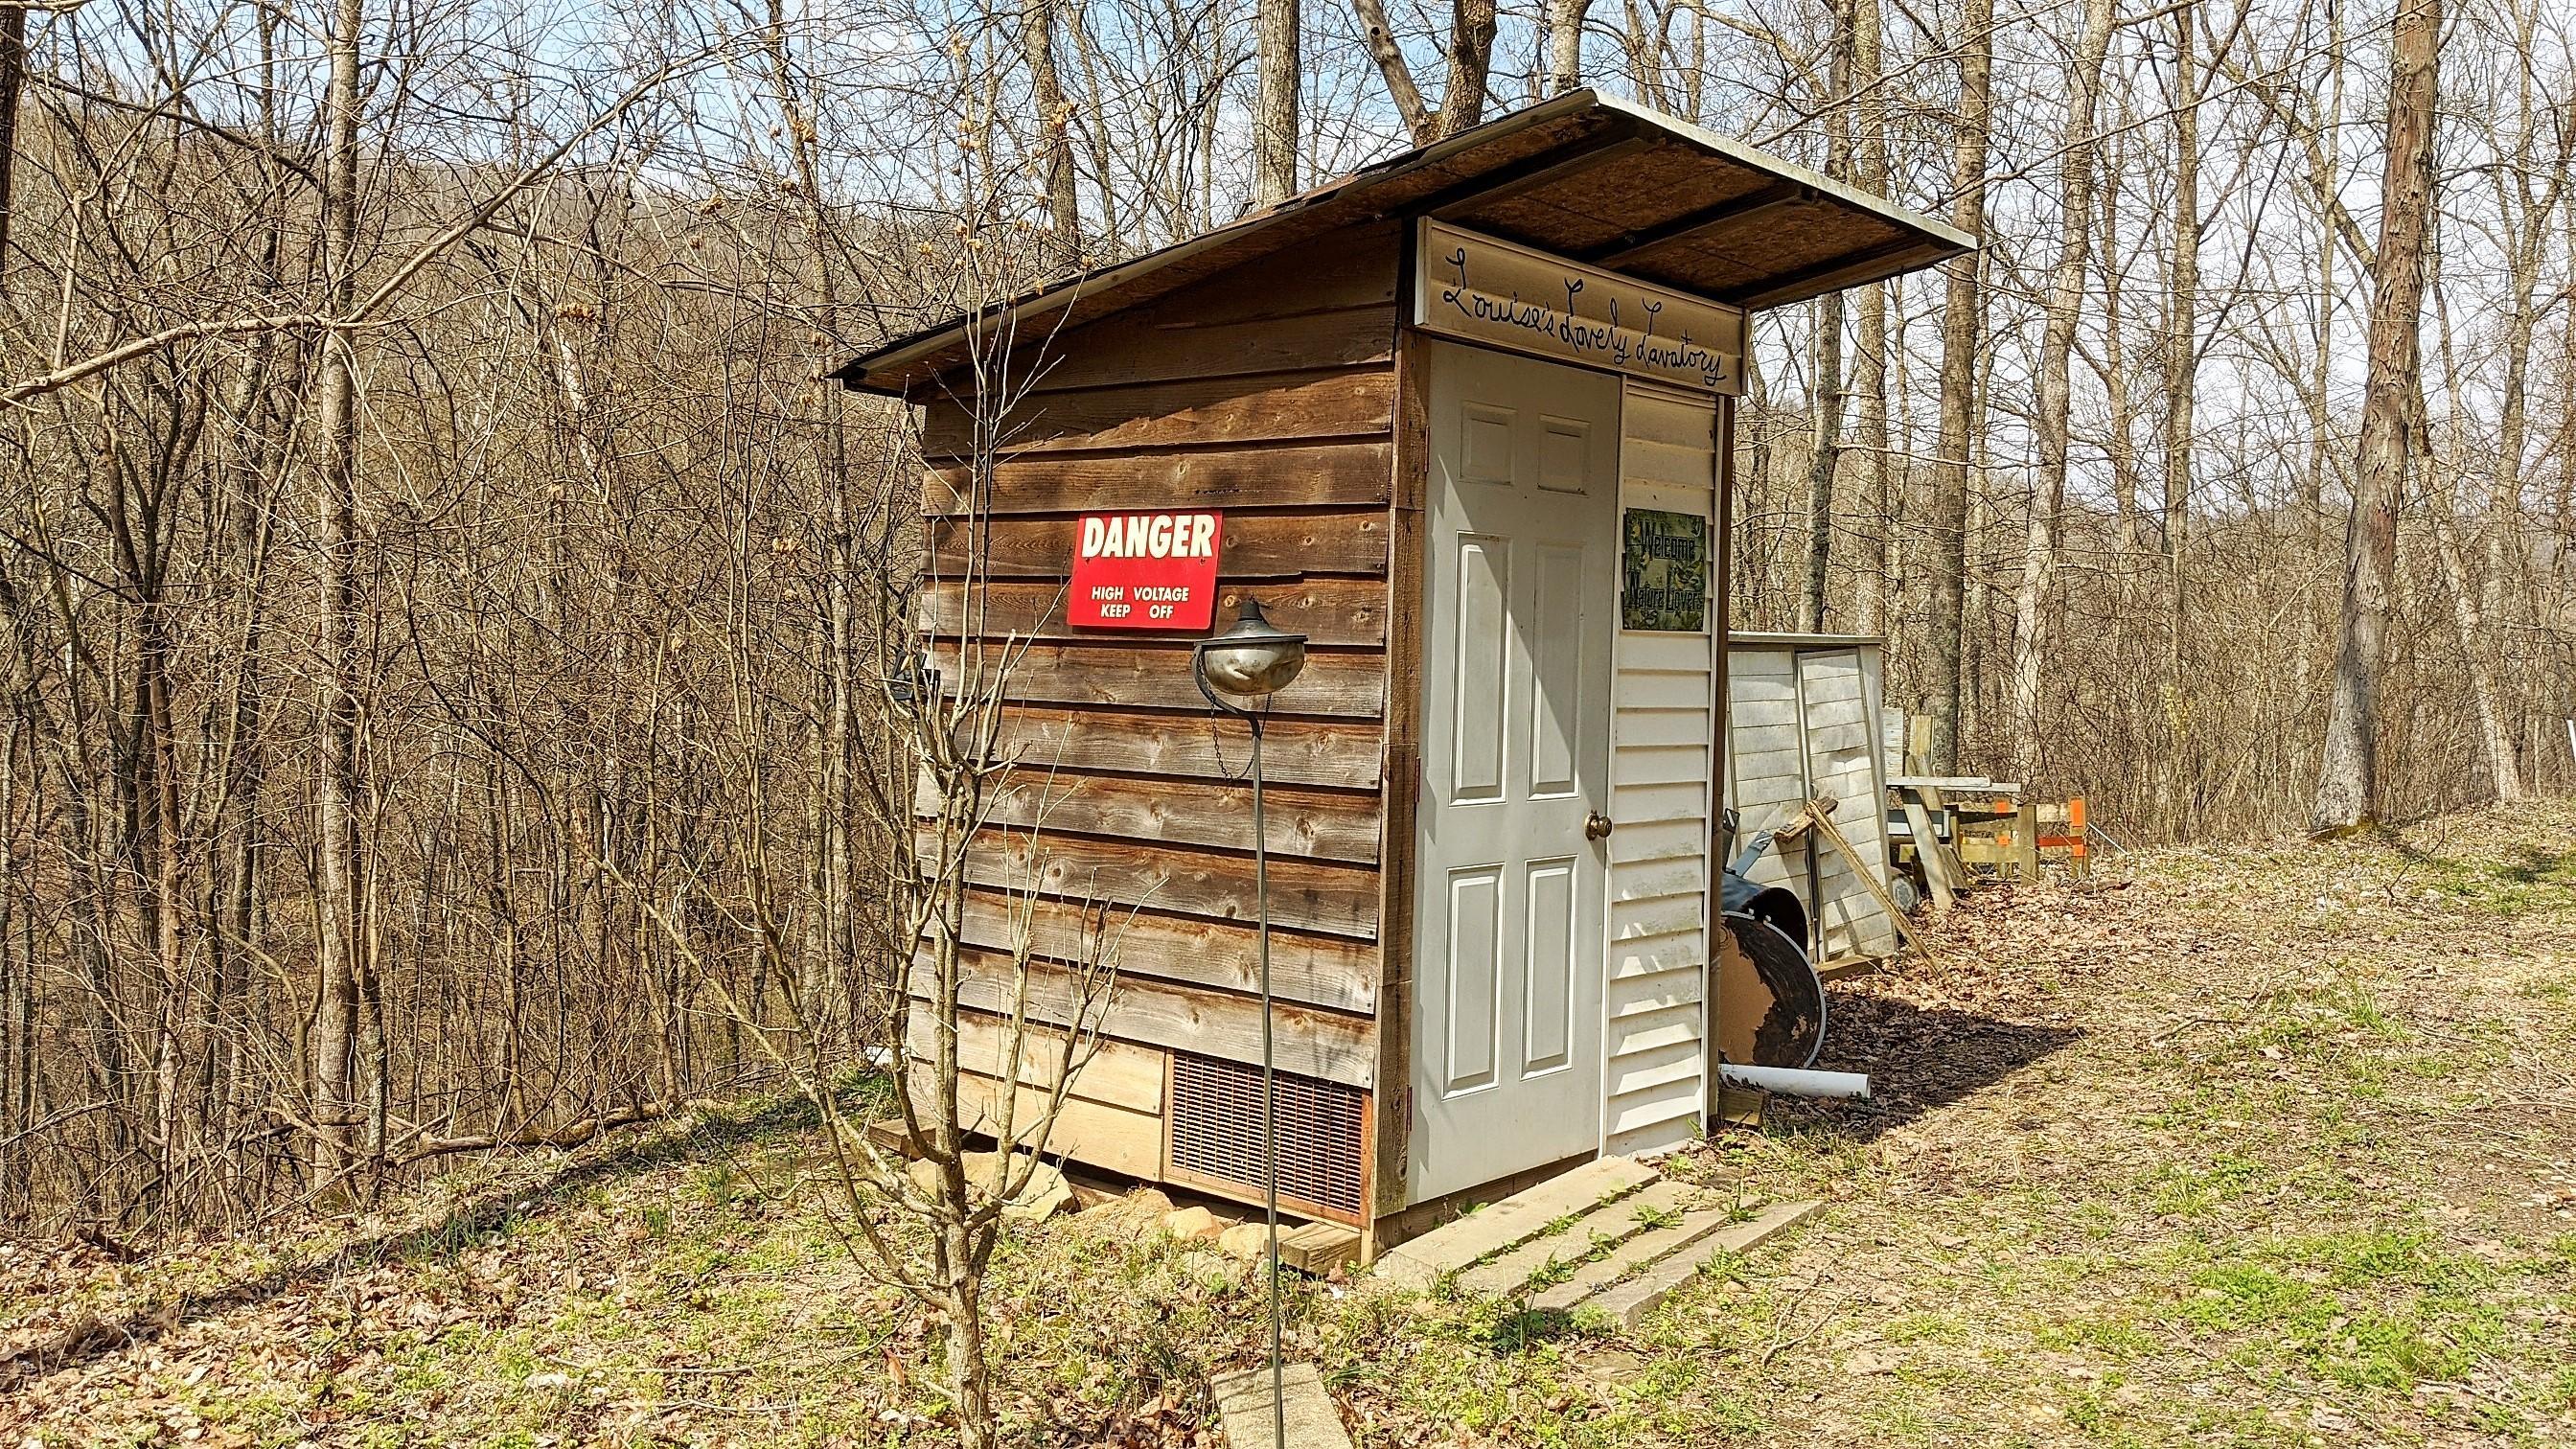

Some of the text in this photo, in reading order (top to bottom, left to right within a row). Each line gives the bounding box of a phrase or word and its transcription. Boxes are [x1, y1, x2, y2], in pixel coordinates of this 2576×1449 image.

[1443, 247, 1727, 386] Louise's Lovely Lavatory
[1081, 515, 1216, 559] DANGER
[1640, 518, 1695, 561] Welcome
[1091, 586, 1190, 602] HIGH VOLTAGE
[1100, 604, 1174, 619] KEEP OFF
[1626, 570, 1703, 613] Nature Lovers
